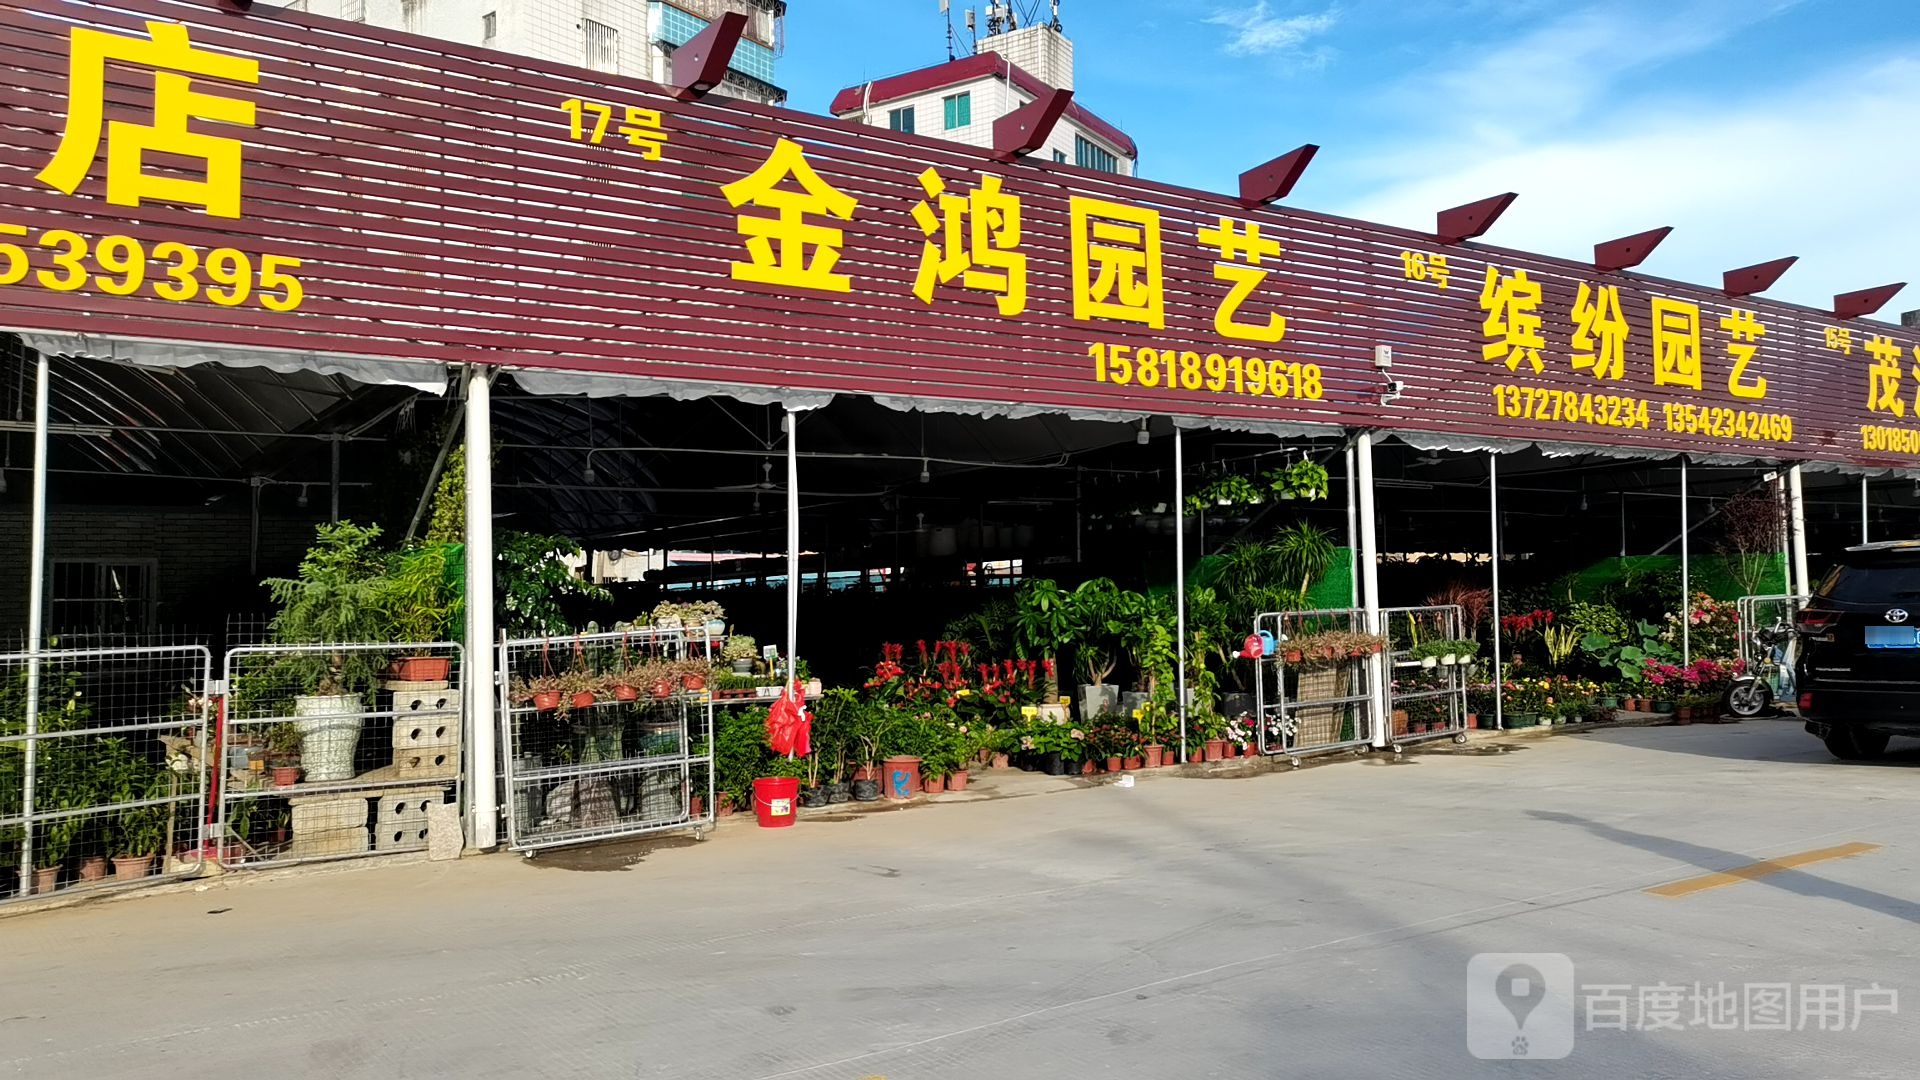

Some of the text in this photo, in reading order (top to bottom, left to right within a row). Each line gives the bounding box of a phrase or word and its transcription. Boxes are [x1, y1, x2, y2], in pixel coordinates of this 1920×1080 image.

[36, 21, 260, 219] 店
[560, 98, 668, 161] 17号
[720, 137, 1287, 343] 金鸿园艺
[1401, 250, 1450, 290] 16号
[1479, 264, 1768, 400] 缤纷园艺
[1824, 326, 1852, 355] 15号
[1087, 342, 1324, 401] 15818919618
[1864, 334, 1920, 418] 茂
[1492, 384, 1794, 442] 13727843234 13542342469
[1860, 424, 1920, 455] 1301850
